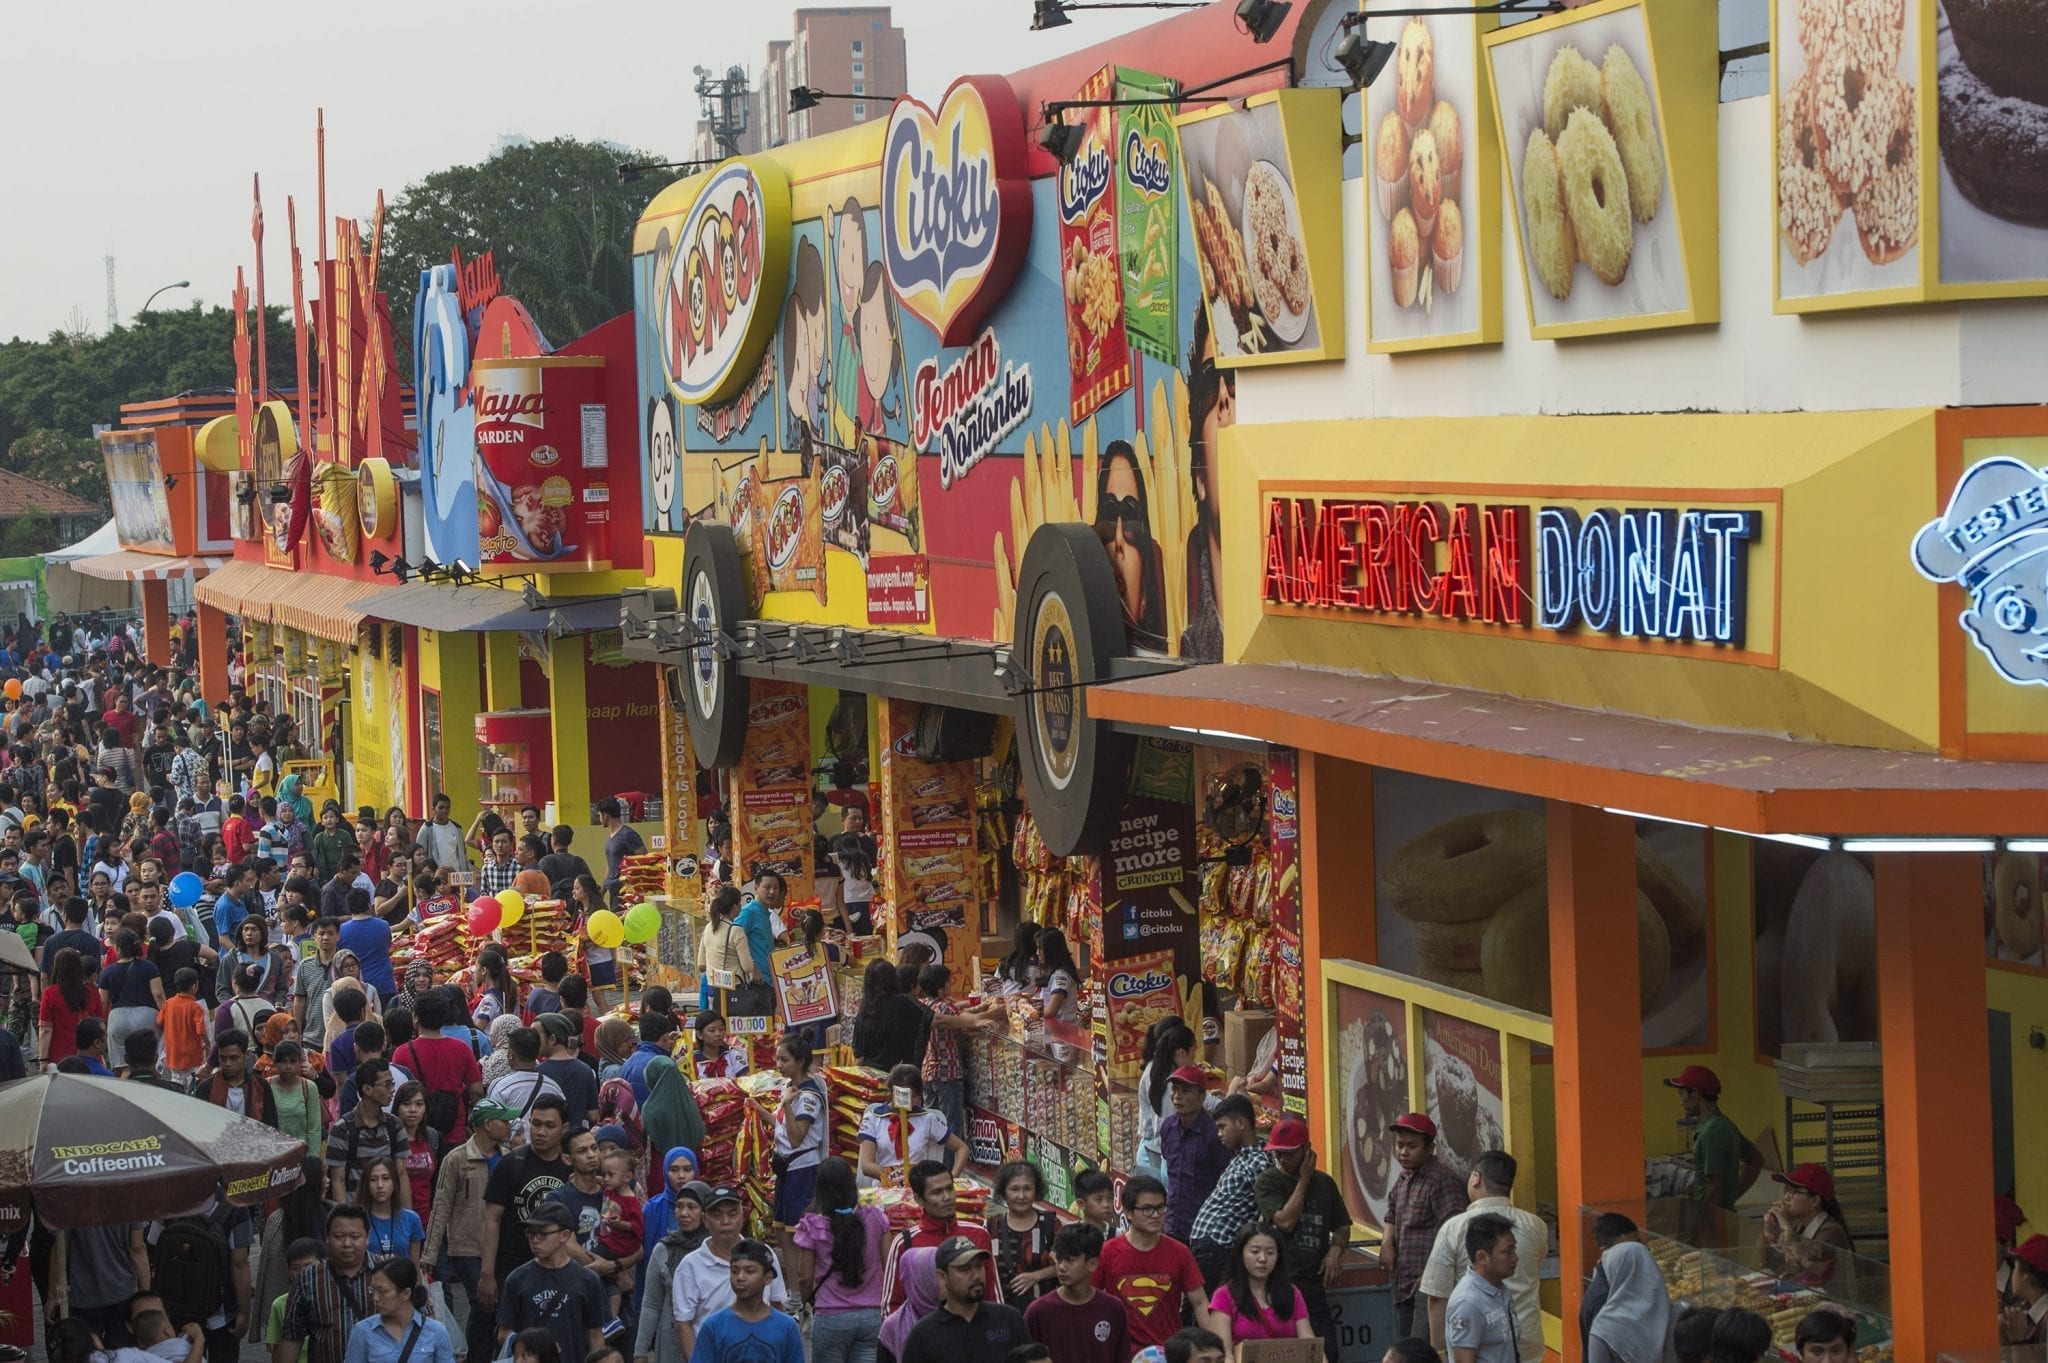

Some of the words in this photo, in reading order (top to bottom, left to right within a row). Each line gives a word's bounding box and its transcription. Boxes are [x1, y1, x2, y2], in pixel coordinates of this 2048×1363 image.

[1126, 130, 1169, 195] Citoku
[886, 117, 998, 289] Citoku
[916, 333, 997, 445] Teman
[941, 370, 1029, 477] Nontonku
[478, 430, 524, 444] SARDEN
[1943, 482, 2048, 554] TESTE
[868, 567, 915, 592] mowngemil.com
[1261, 497, 1531, 630] AMERICAN
[1536, 506, 1763, 650] DONAT
[1049, 671, 1065, 693] BEST
[625, 703, 658, 716] Ikan
[1045, 694, 1071, 715] BRAND
[675, 712, 685, 776] SCHOOL
[675, 781, 690, 792] IS
[744, 791, 794, 801] mowngemil.com
[676, 797, 689, 842] COOL
[1120, 814, 1160, 832] new
[900, 832, 956, 842] mowngemil.com
[1110, 827, 1180, 853] recipe
[1114, 846, 1182, 873] more
[1118, 869, 1183, 889] CRUNCHY!
[426, 901, 452, 913] Citoku
[1140, 909, 1173, 918] citoku
[1139, 923, 1183, 937] @citoku
[1108, 970, 1172, 998] Citoku
[730, 1017, 766, 1031] 10.000
[1285, 1038, 1299, 1050] new
[1436, 1020, 1477, 1065] American
[1281, 1051, 1305, 1073] recipe
[1283, 1073, 1306, 1090] more
[969, 1112, 997, 1142] eman
[51, 1134, 161, 1158] INDOCAFÉ
[64, 1153, 166, 1175] Coffeemix
[227, 1170, 270, 1196] INDOCAFÉ
